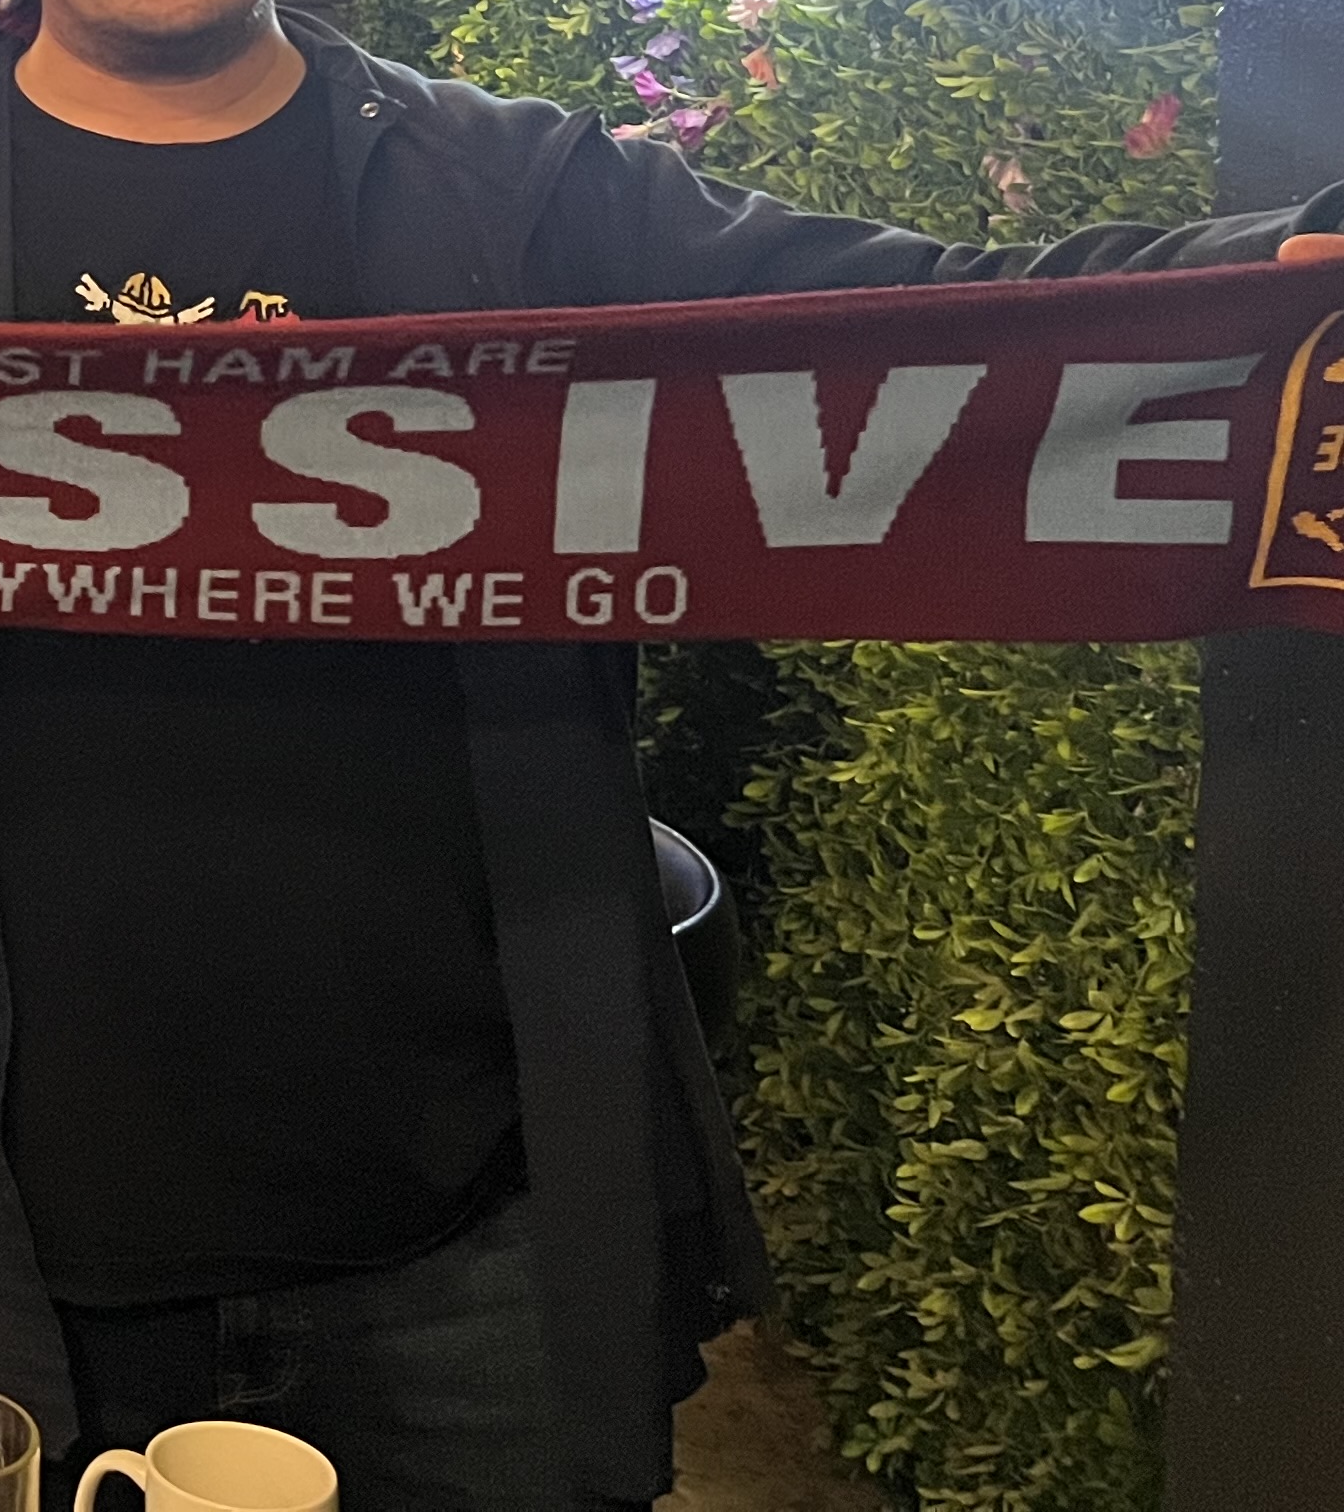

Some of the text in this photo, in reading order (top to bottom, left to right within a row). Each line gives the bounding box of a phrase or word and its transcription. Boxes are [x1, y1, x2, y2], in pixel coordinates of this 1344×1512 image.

[142, 345, 357, 385] HAM
[388, 339, 579, 383] ARE
[392, 570, 526, 628] WE
[565, 566, 689, 626] GO
